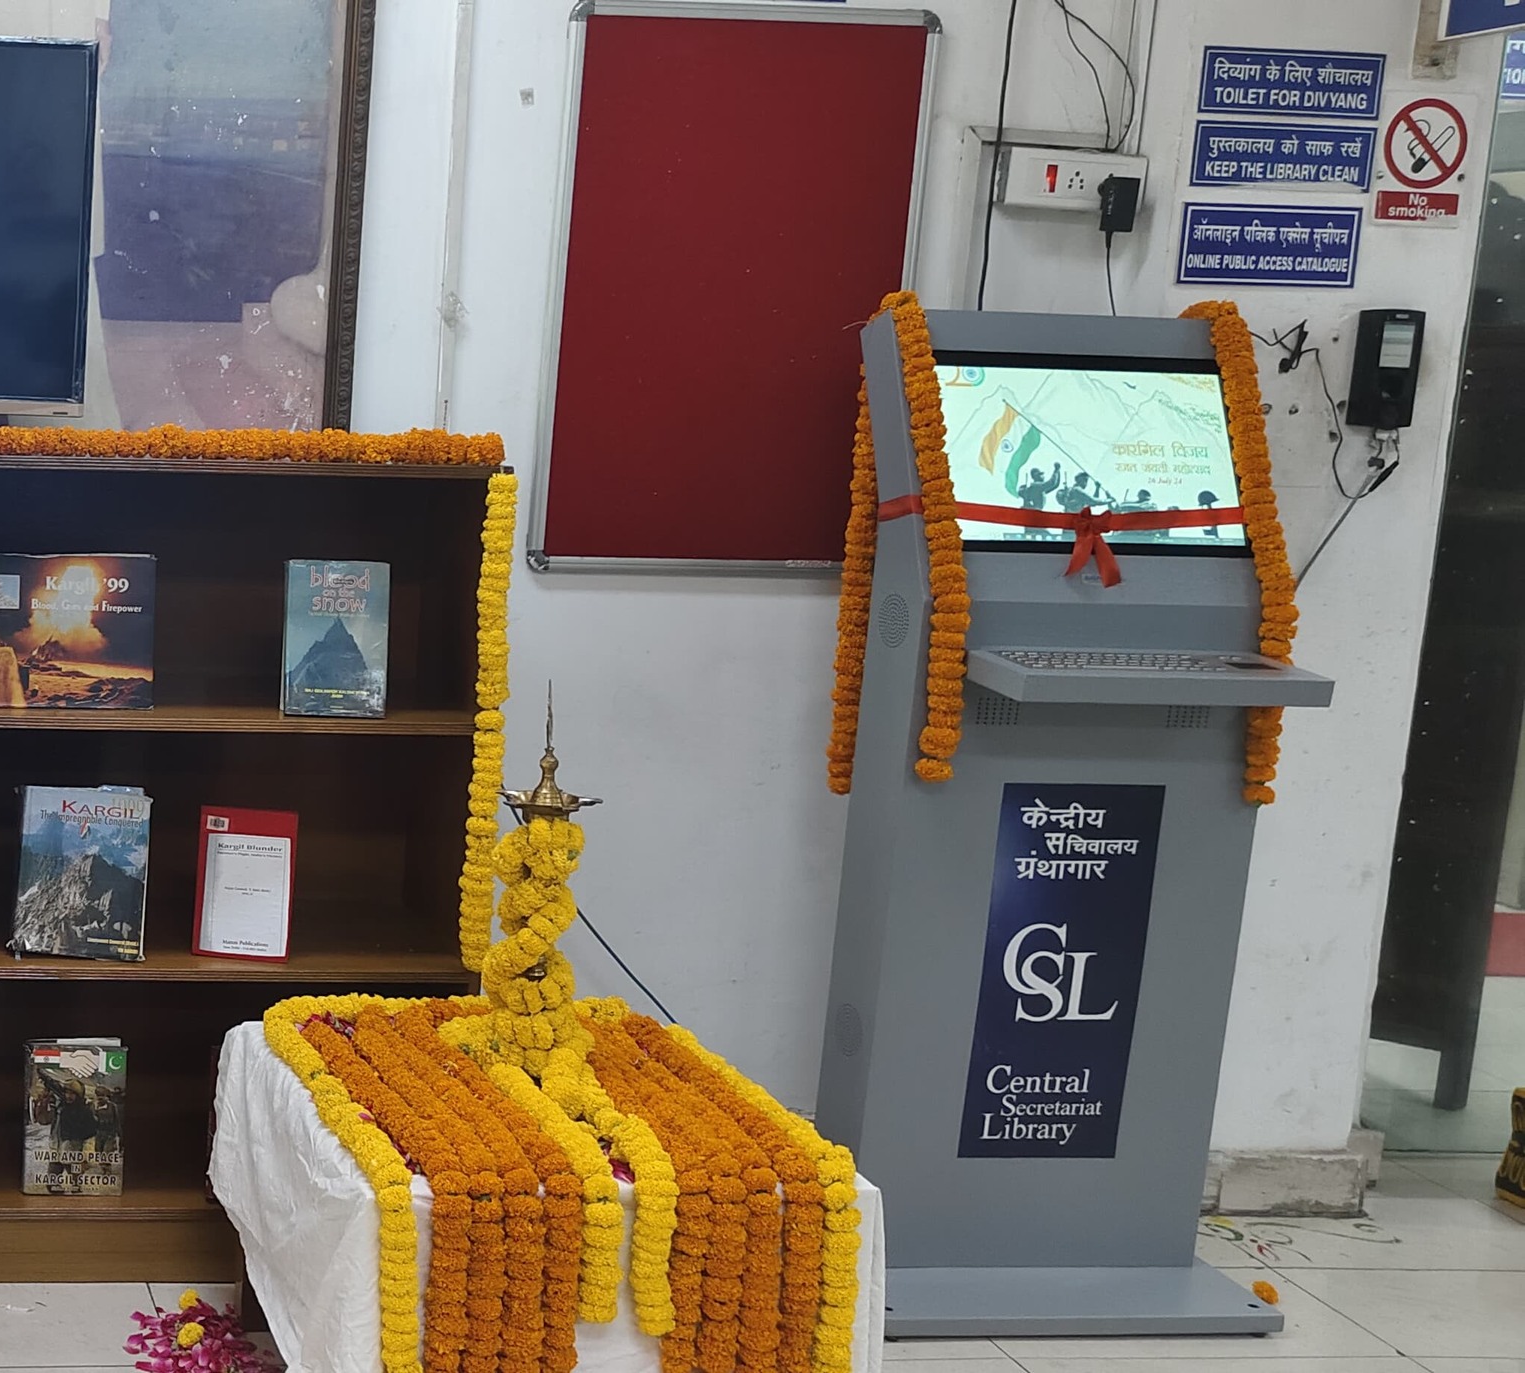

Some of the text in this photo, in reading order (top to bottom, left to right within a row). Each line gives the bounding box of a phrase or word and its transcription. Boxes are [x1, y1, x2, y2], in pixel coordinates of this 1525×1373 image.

[1214, 57, 1373, 86] दिव्यांग के लिए शौचालय
[1214, 87, 1367, 110] TOILET FOR DIVYANG
[1209, 135, 1362, 158] पुस्तकालय को साफ रखें
[1205, 161, 1359, 182] KEEP THE LIBRARY CLEAN
[1409, 194, 1427, 206] No
[1193, 218, 1349, 252] ऑनलाइन पब्लिक एक्सेस सूचीपत्र
[1187, 254, 1348, 273] ONLINE PUBLIC ACCESS CATALOGUE
[1112, 440, 1164, 457] कारगिल
[45, 576, 100, 594] Kargil
[310, 565, 370, 592] blood
[102, 600, 142, 614] Firepower
[312, 596, 367, 612] snow
[62, 800, 140, 819] KARGIL
[1020, 798, 1106, 829] केन्द्रीय
[104, 816, 143, 828] Conquered
[247, 844, 282, 852] Blunder
[1044, 832, 1139, 855] सचिवालय
[1014, 850, 1109, 880] ग्रंथागार
[1003, 922, 1118, 1022] CSL
[986, 1065, 1090, 1094] Central
[1000, 1094, 1102, 1116] Secretariat
[980, 1113, 1076, 1145] Library
[34, 1151, 120, 1163] WAR AND PEACE
[72, 1164, 81, 1172] IN
[35, 1175, 117, 1186] KARGIL SECTOR
